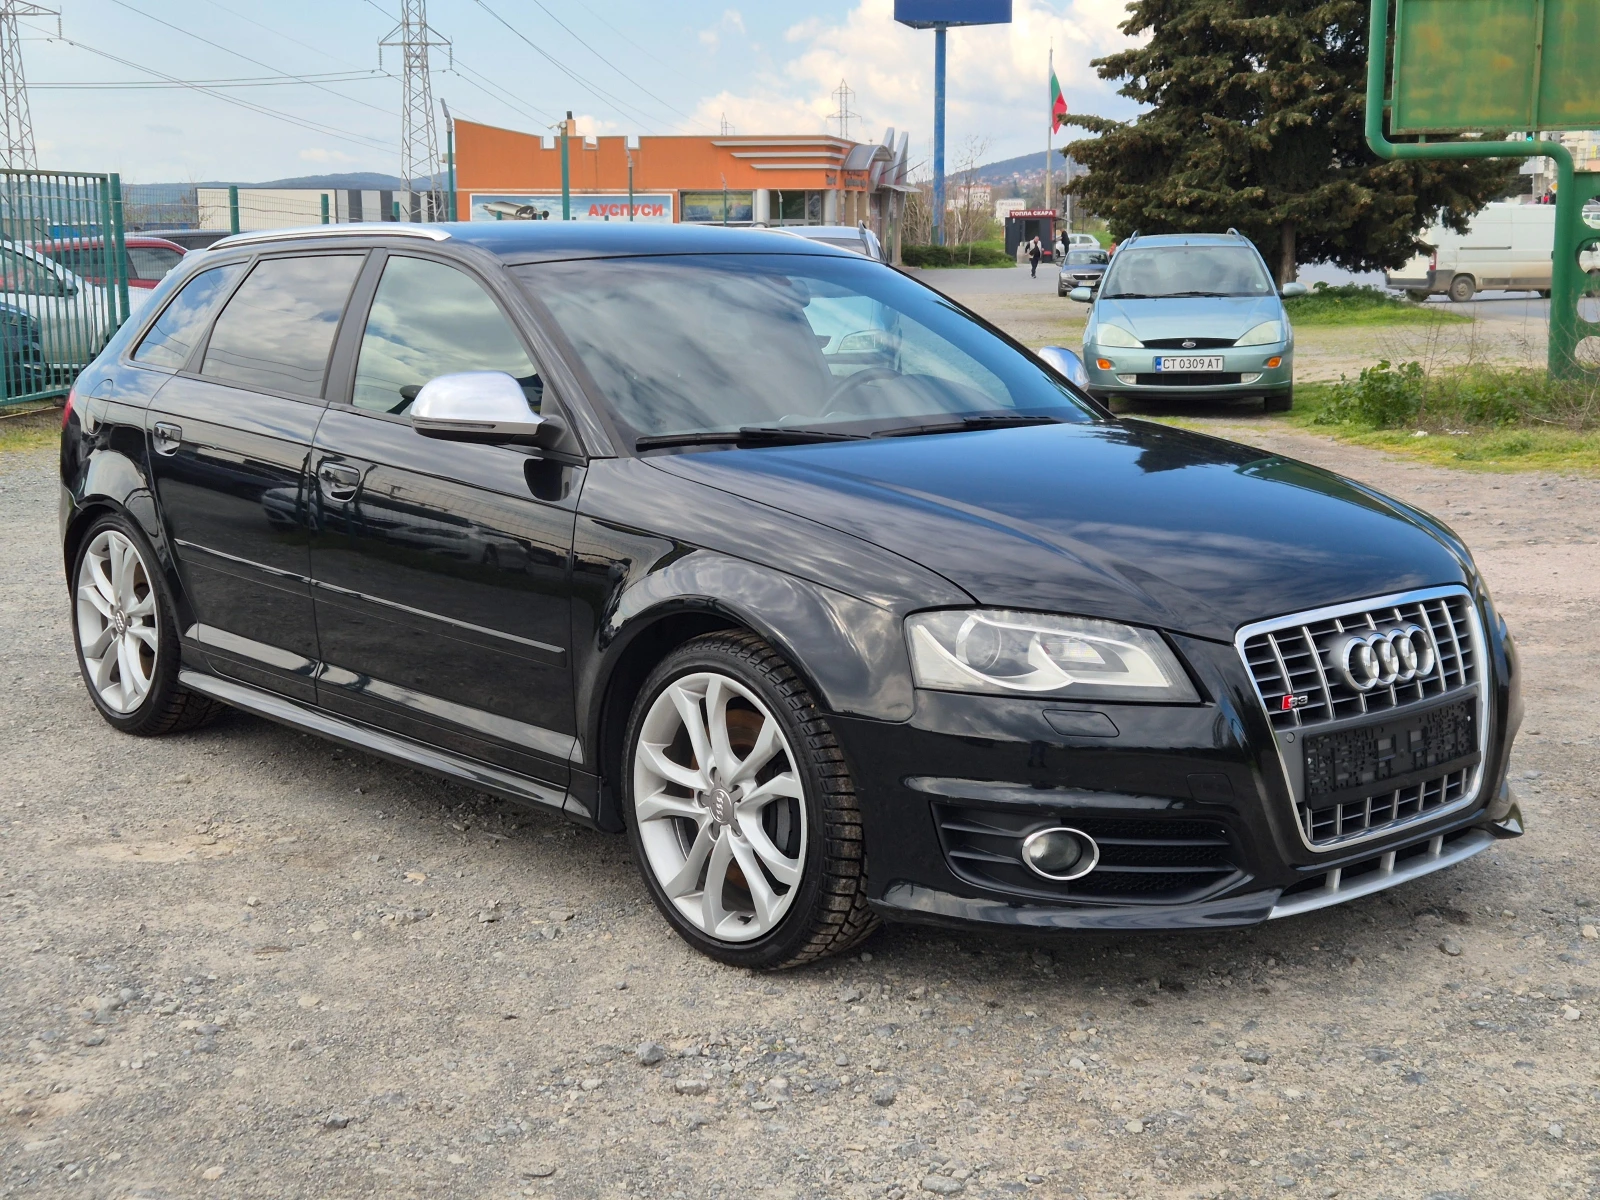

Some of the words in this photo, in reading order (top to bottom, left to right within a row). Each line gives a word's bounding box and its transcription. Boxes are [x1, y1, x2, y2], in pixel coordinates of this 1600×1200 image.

[588, 204, 663, 216] АУСПУСИ
[1163, 358, 1177, 369] CT
[1179, 358, 1205, 369] 0309
[1207, 358, 1221, 369] AT
[1287, 695, 1308, 708] S3
